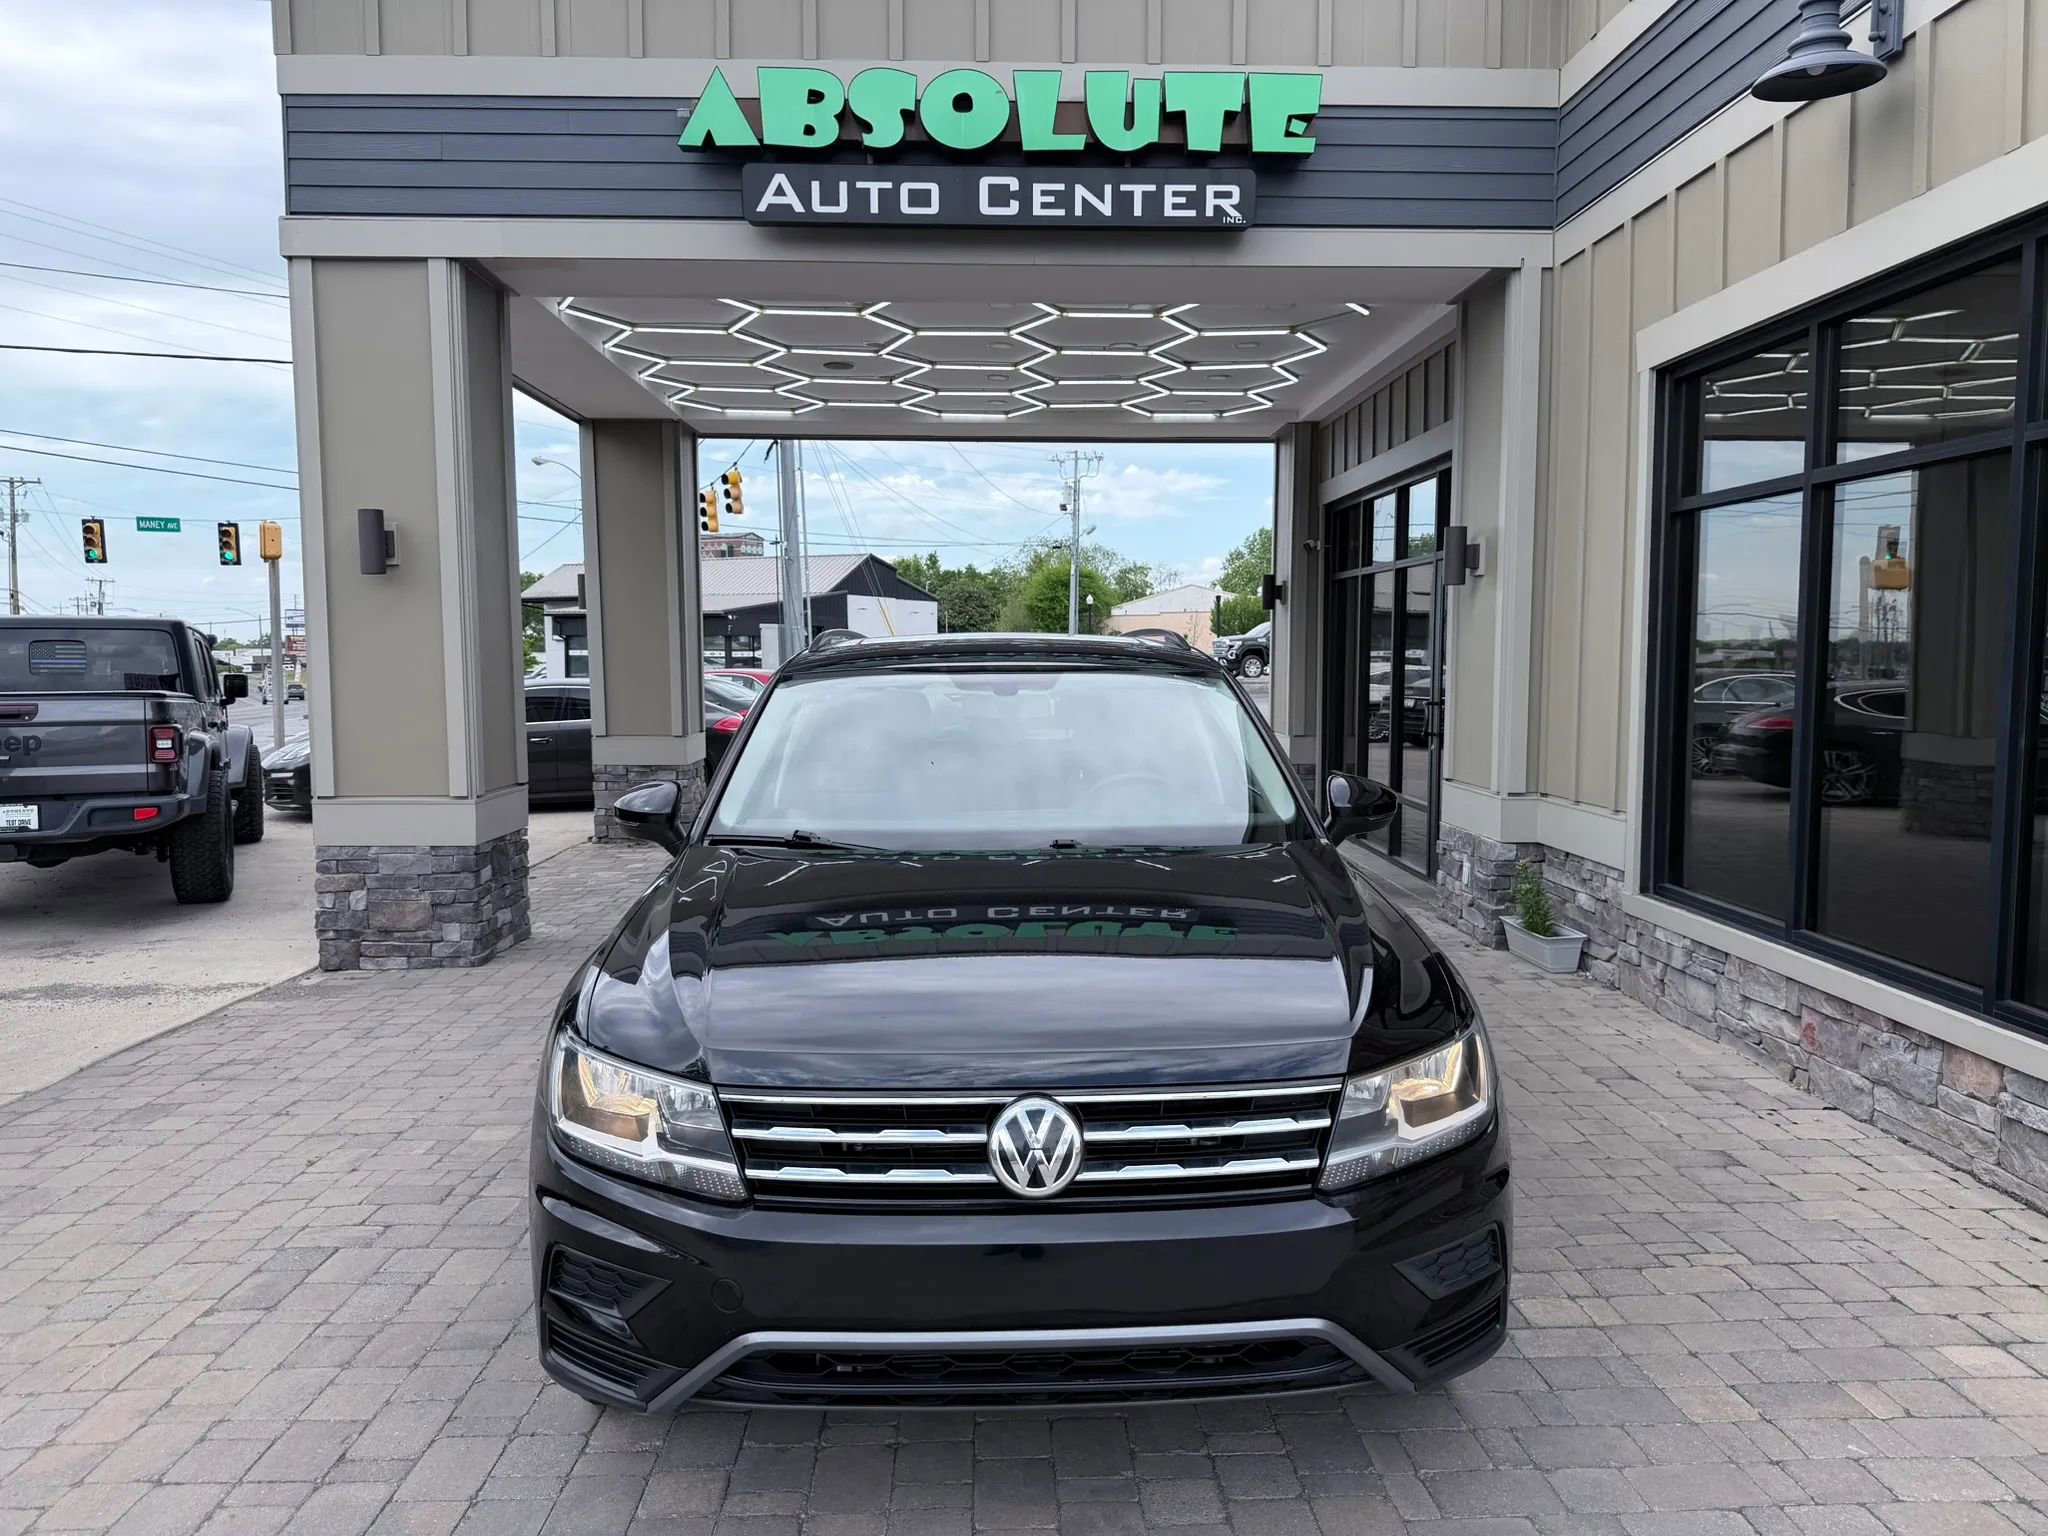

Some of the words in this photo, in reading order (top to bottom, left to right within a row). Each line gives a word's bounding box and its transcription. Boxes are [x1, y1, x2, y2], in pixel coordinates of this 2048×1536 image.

[677, 65, 1323, 153] ABSOLUTE
[756, 173, 940, 214] AUTO
[979, 176, 1242, 218] CENTER
[1222, 216, 1247, 224] INC.
[139, 520, 165, 529] MANEY
[991, 1099, 1079, 1194] VW
